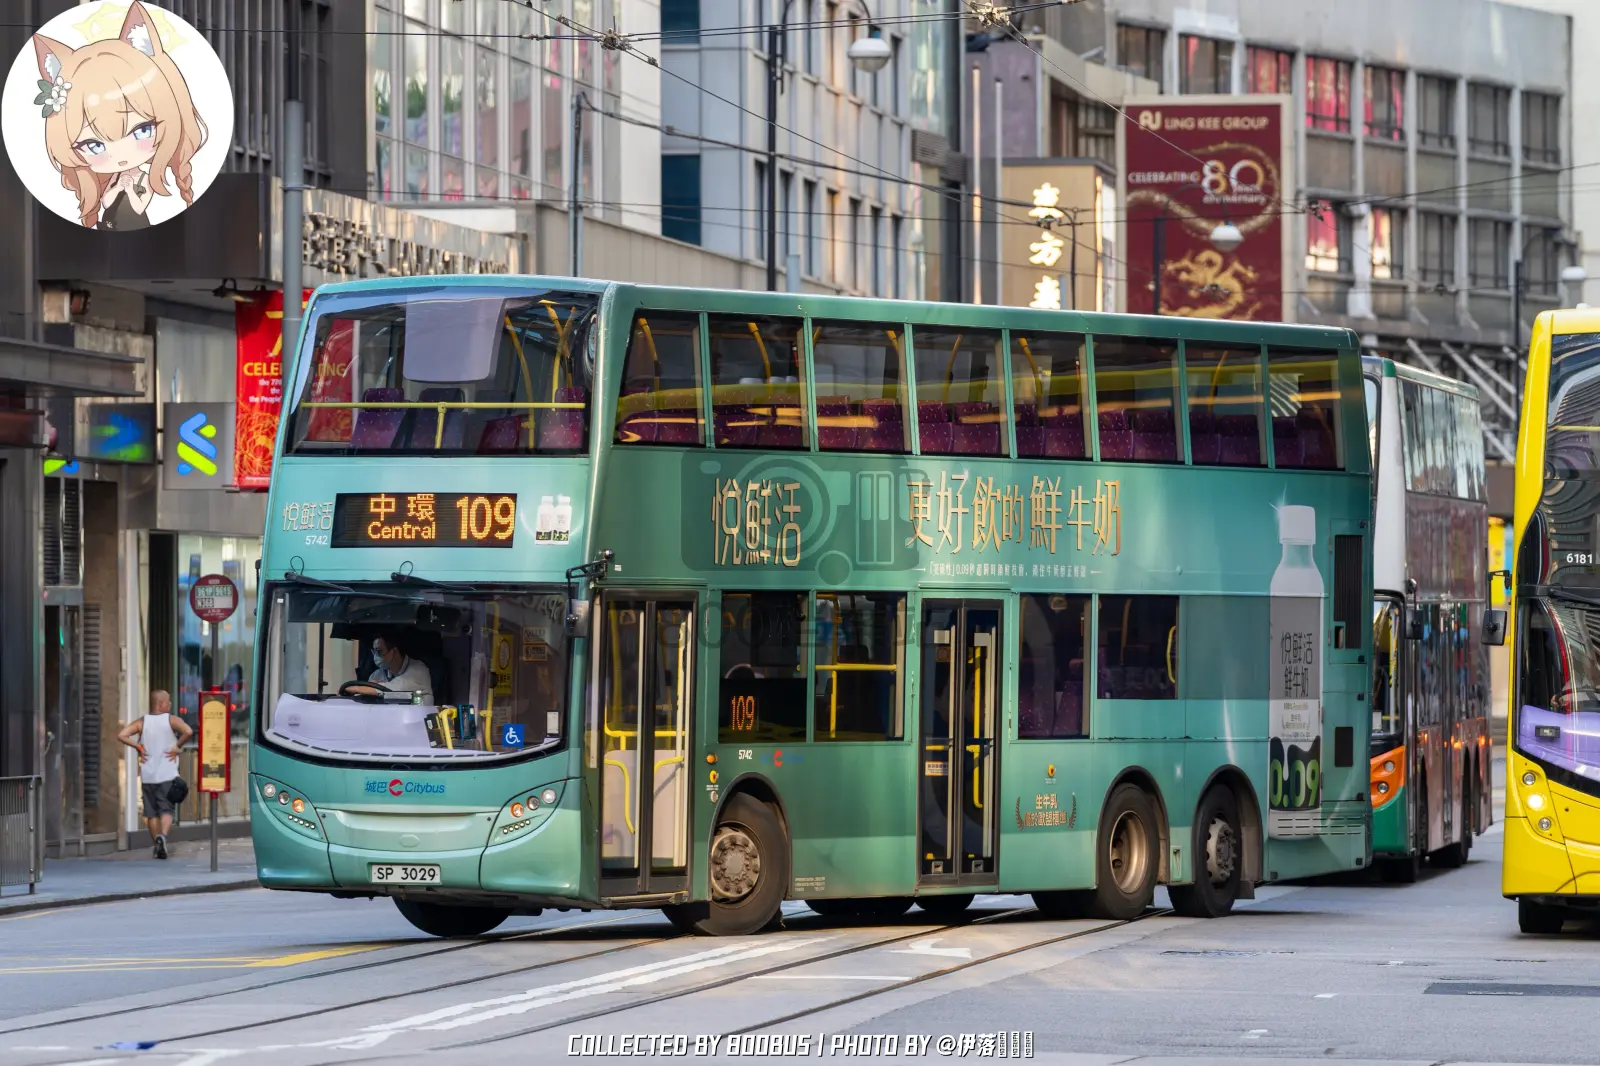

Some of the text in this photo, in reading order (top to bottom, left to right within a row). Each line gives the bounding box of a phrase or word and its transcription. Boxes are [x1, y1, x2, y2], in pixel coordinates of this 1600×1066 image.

[1164, 116, 1268, 130] LING KEE GROUP
[1128, 159, 1263, 194] CELEBRATING 80
[369, 493, 435, 521] 中環
[456, 496, 515, 540] 109
[906, 469, 1121, 556] 更好飲的鮮牛奶
[367, 521, 436, 540] Central
[305, 535, 328, 546] 5742
[1566, 553, 1593, 564] 6181
[1284, 666, 1309, 698] 鮮牛奶
[731, 695, 755, 731] 109
[738, 749, 752, 760] 5742
[364, 780, 446, 795] 城巴 Citybus
[1270, 758, 1320, 808] 0.09
[377, 867, 436, 881] SP 3029
